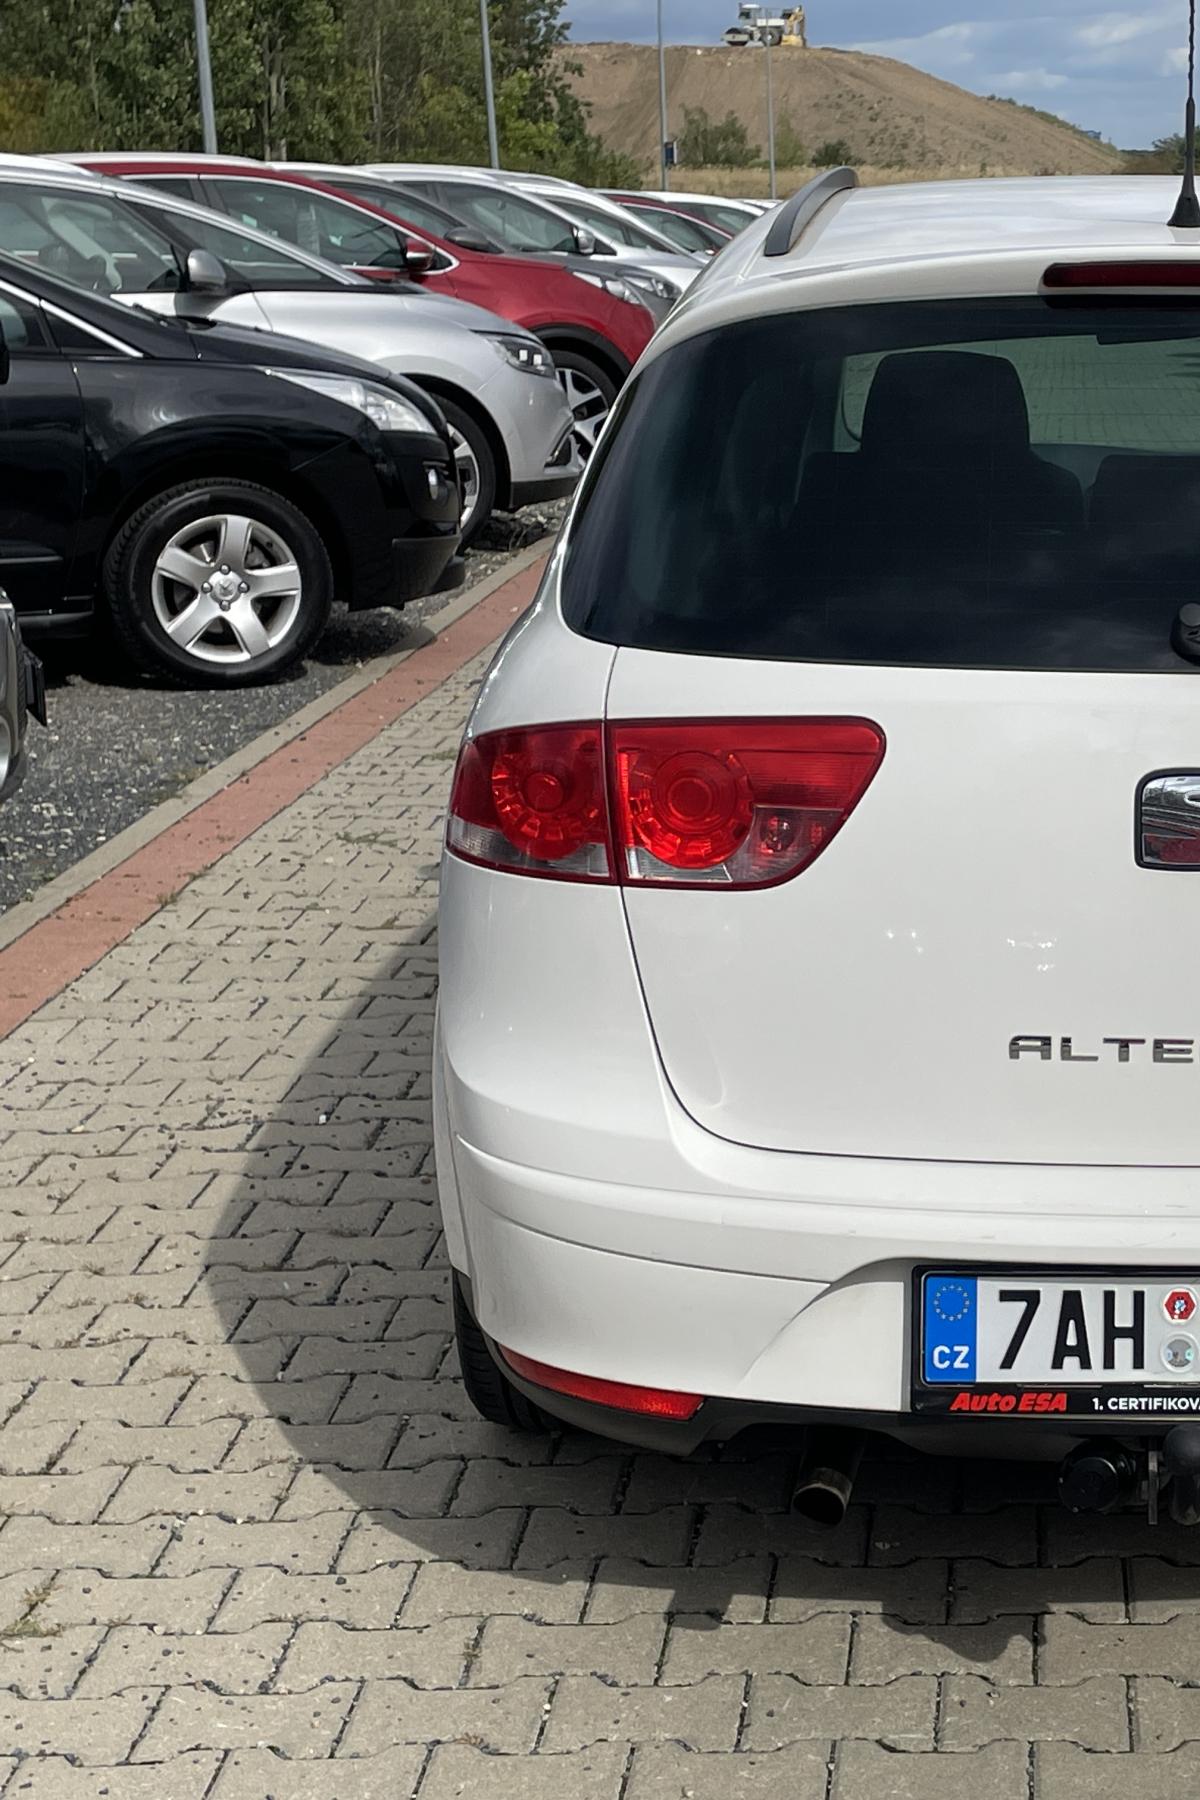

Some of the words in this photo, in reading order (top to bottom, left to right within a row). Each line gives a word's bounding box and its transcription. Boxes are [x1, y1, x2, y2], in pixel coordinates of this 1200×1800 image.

[999, 1289, 1145, 1370] 7AH
[932, 1345, 970, 1369] CZ
[950, 1392, 1017, 1412] Auto
[1017, 1392, 1068, 1412] ESA
[1092, 1397, 1104, 1411] 1.
